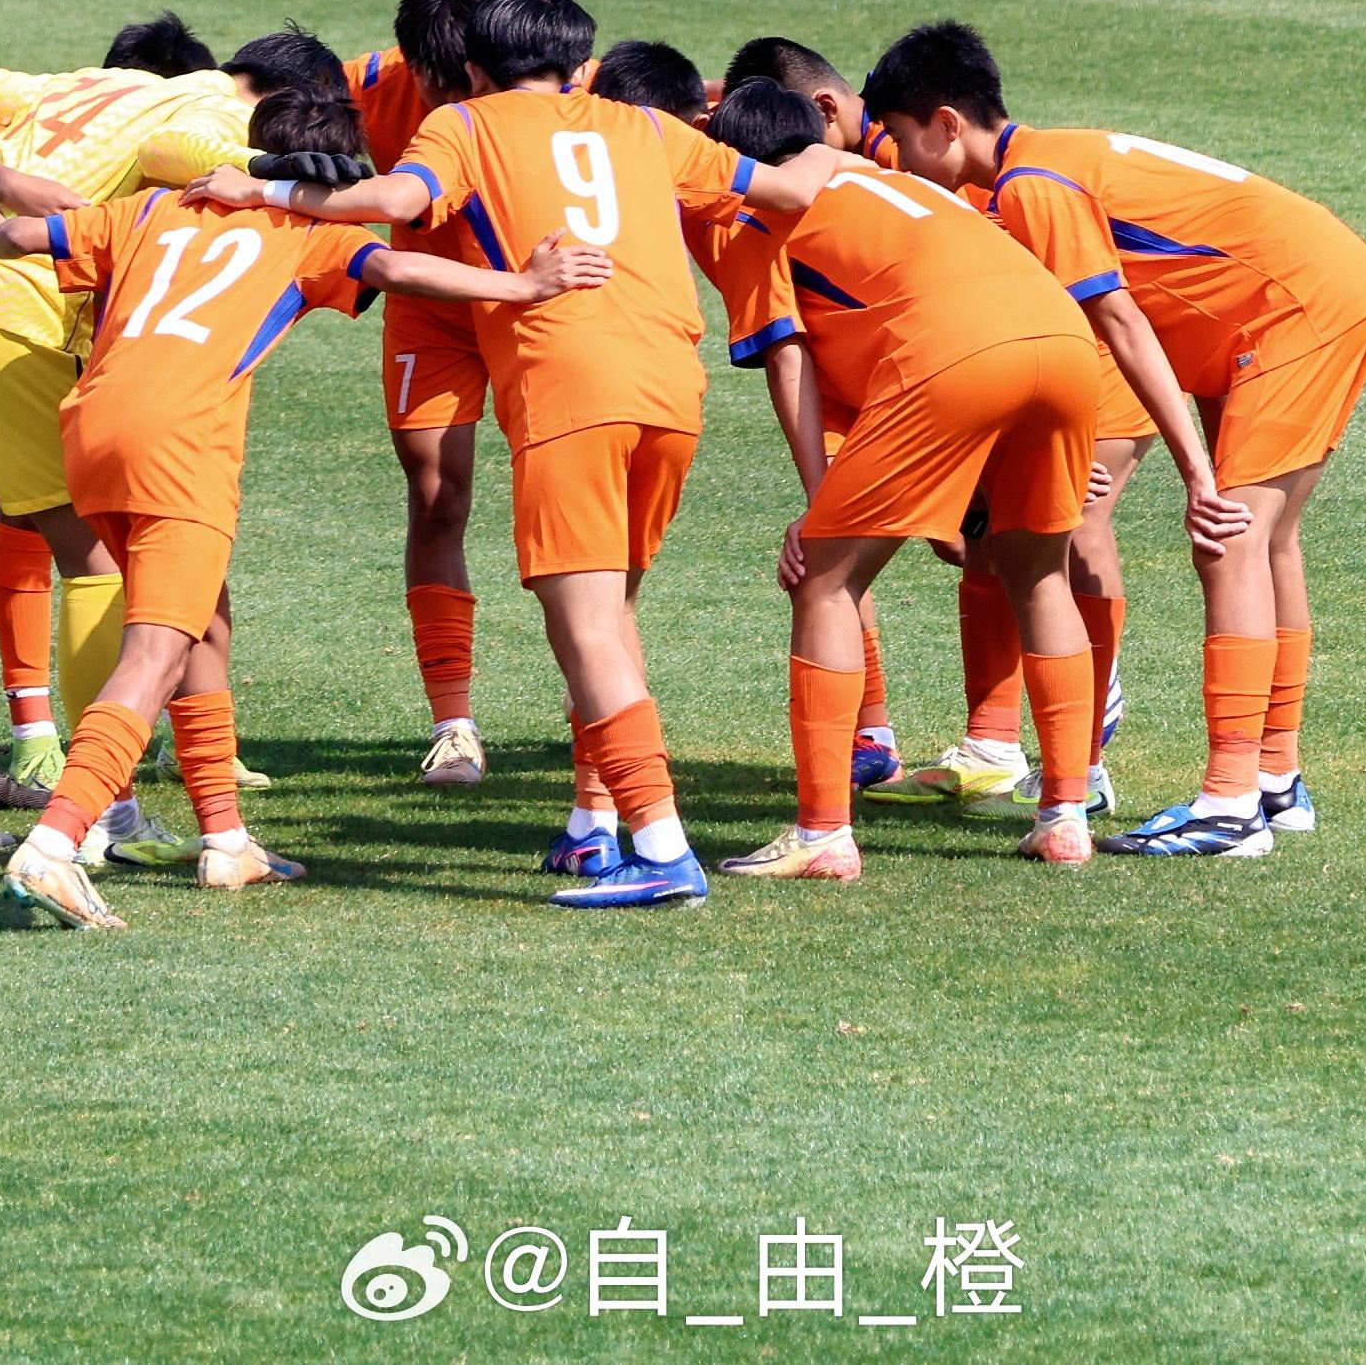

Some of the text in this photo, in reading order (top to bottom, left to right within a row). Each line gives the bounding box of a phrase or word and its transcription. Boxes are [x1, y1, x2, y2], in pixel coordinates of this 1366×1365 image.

[551, 130, 619, 246] 9
[122, 227, 262, 344] 12
[395, 353, 416, 413] 7
